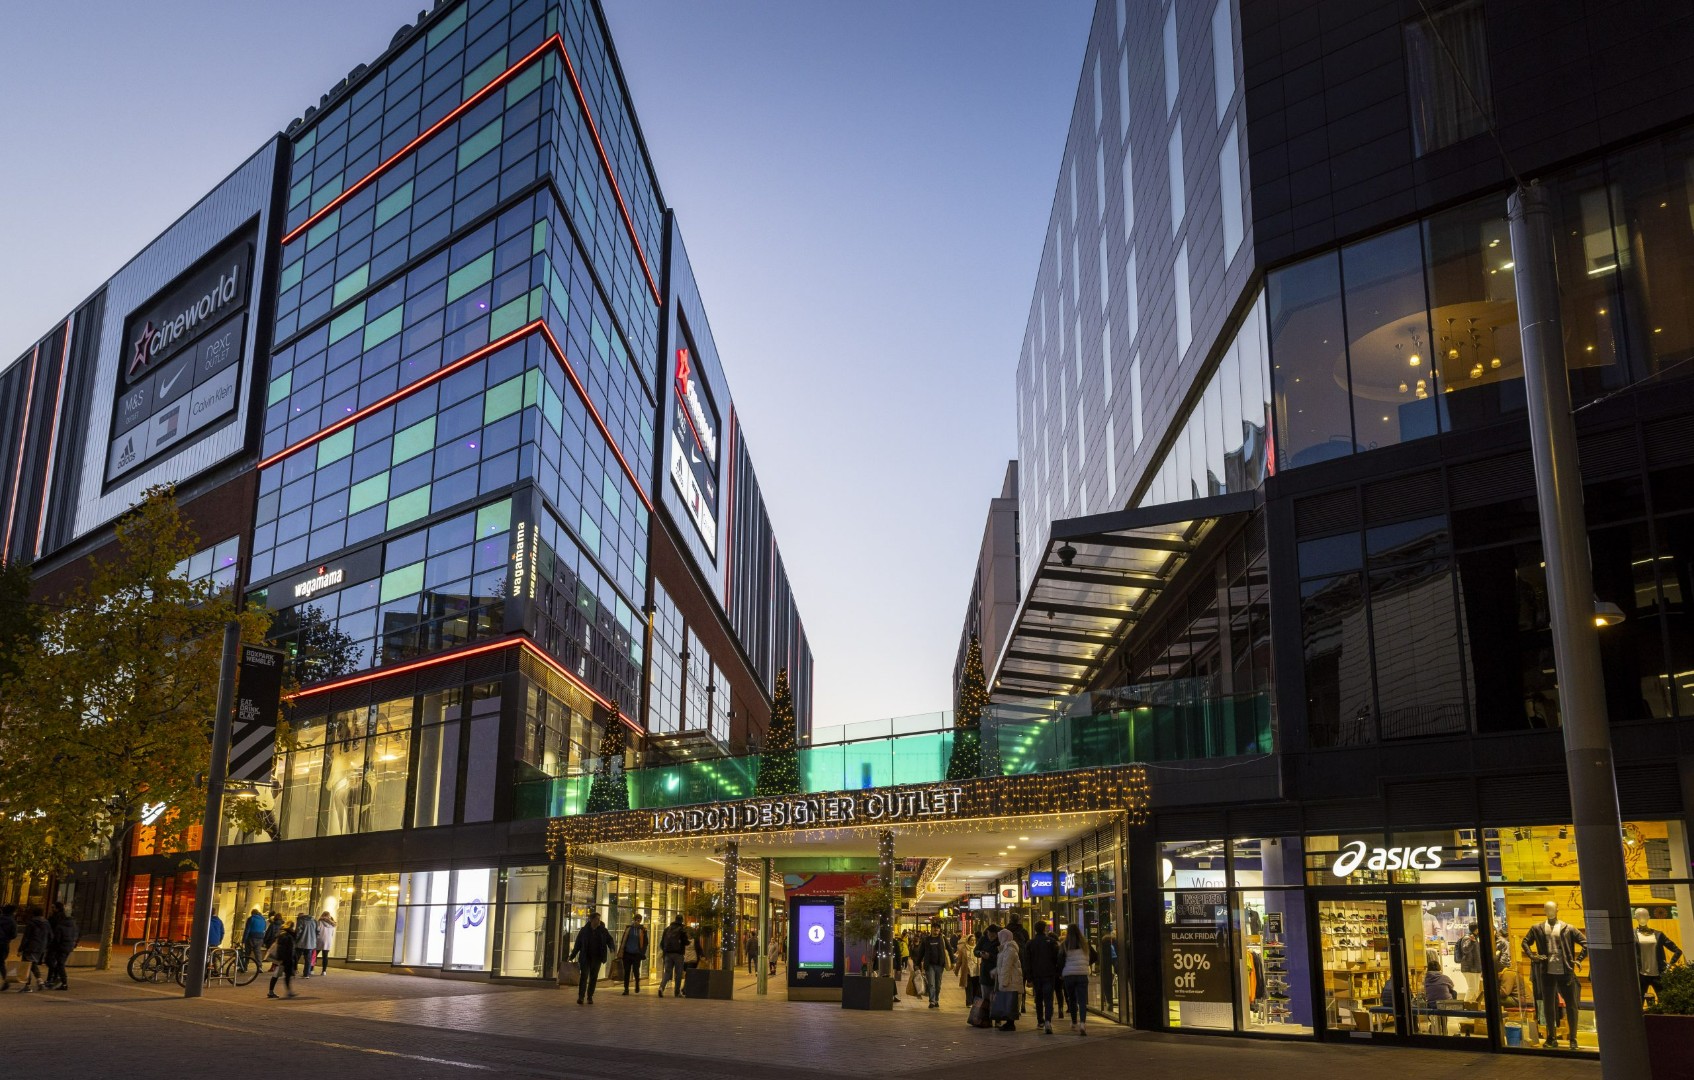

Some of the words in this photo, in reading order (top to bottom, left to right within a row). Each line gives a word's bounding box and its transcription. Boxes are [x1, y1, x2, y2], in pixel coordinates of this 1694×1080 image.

[149, 264, 239, 356] cineworld
[207, 332, 232, 360] next
[205, 348, 231, 371] OUTLET
[124, 389, 145, 415] M&S
[192, 396, 215, 416] Calvin
[214, 384, 233, 402] Klein
[117, 452, 136, 470] adidas
[513, 521, 525, 597] wagamama
[529, 524, 539, 599] wagamama
[294, 569, 343, 598] wagamama
[245, 656, 277, 667] WEMBLEY
[246, 649, 275, 661] BOXPARK
[653, 806, 737, 835] LONDON
[743, 797, 855, 828] DESIGNER
[866, 787, 962, 820] OUTLET
[1367, 845, 1443, 871] asics
[1183, 893, 1222, 905] INSPIRED
[814, 928, 820, 939] 1
[1171, 932, 1194, 940] BLACK
[1194, 932, 1218, 940] FRIDAY
[1173, 953, 1211, 970] 30%
[1174, 972, 1196, 988] off
